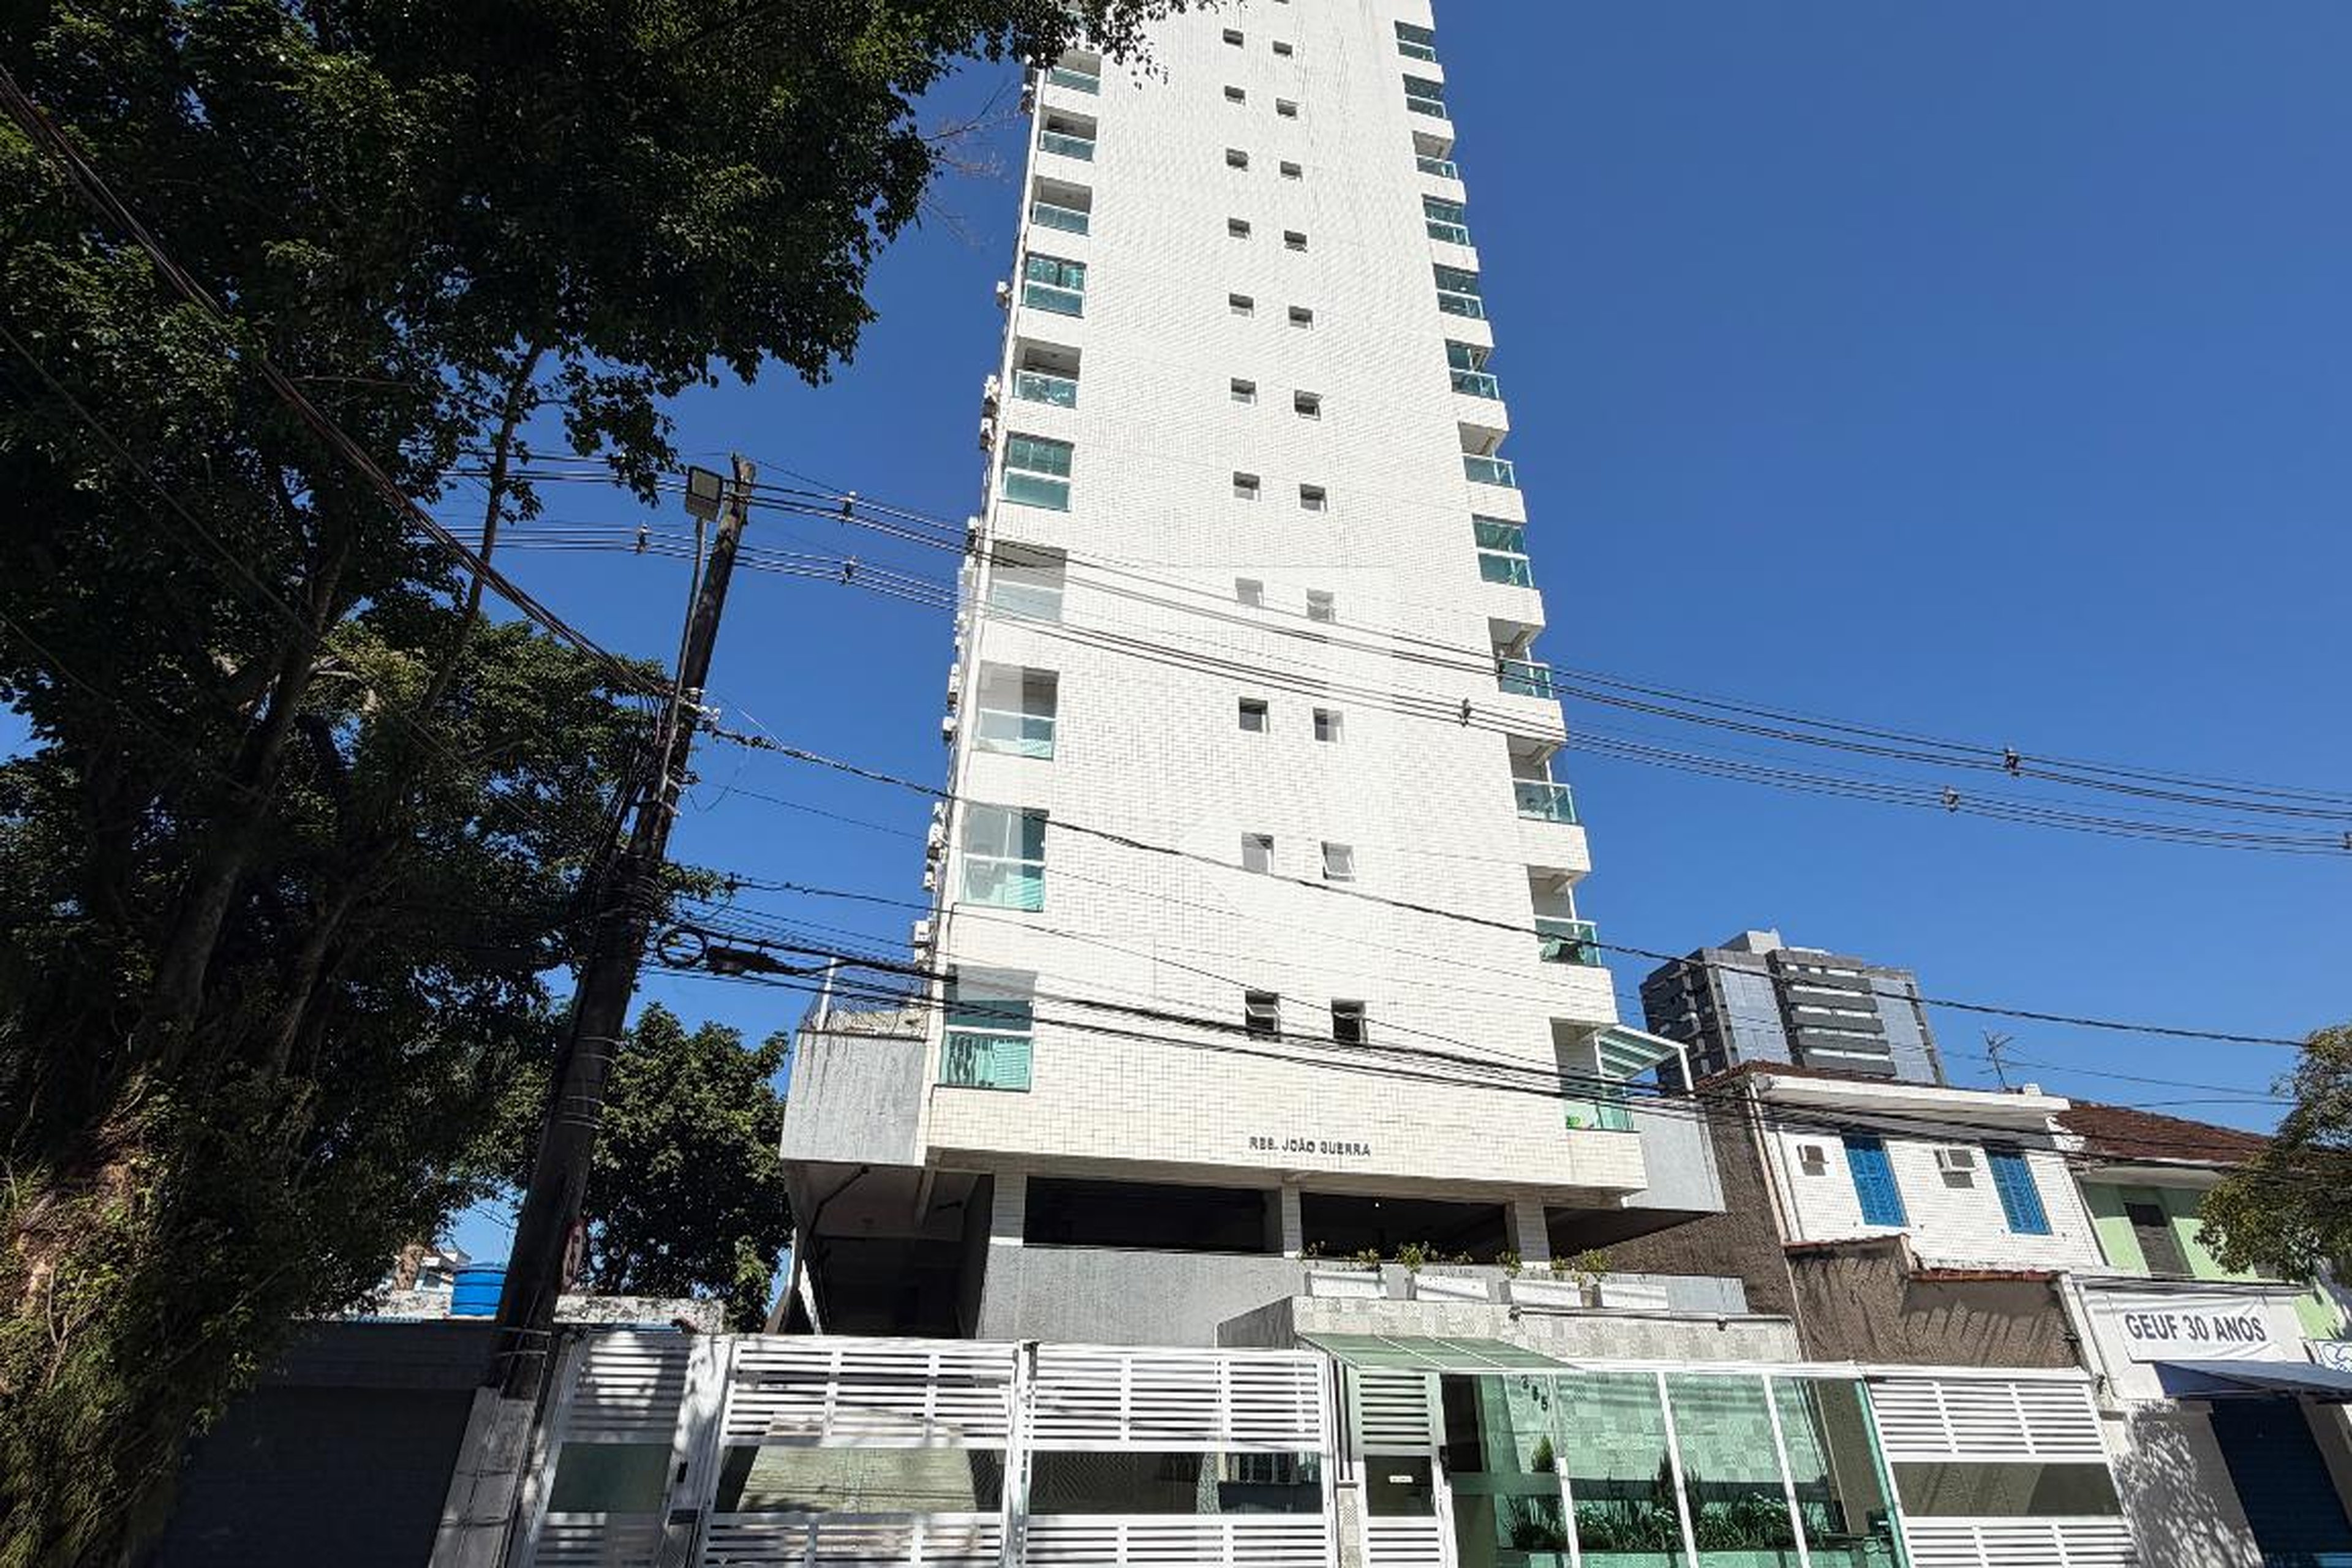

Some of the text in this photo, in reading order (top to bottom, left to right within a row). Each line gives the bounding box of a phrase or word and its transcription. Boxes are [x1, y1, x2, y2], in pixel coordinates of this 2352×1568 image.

[1282, 1137, 1316, 1154] JOÃO
[1321, 1141, 1371, 1156] GUERRA
[2125, 1314, 2267, 1342] GEUF 30 ANOS
